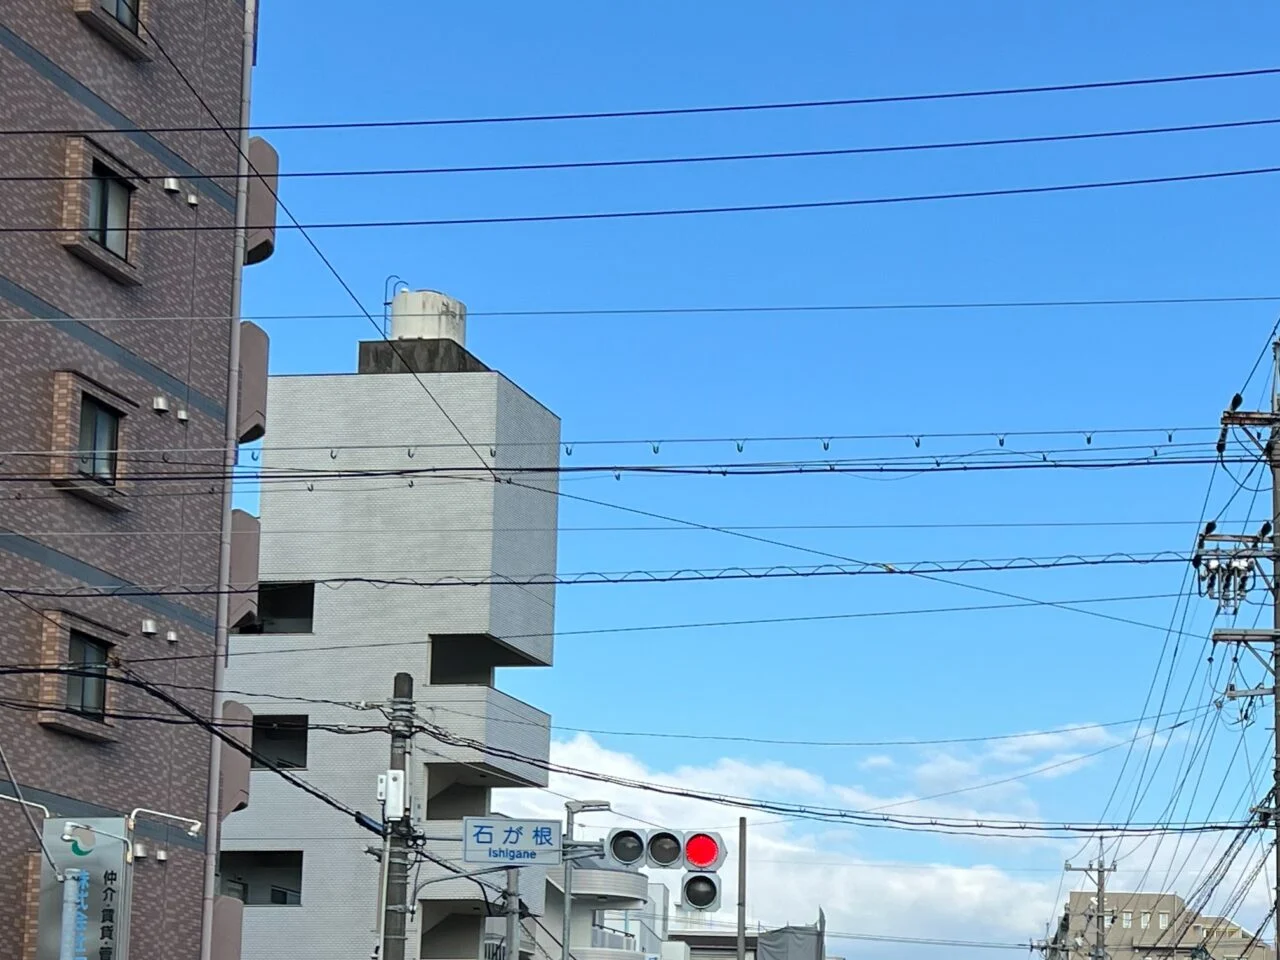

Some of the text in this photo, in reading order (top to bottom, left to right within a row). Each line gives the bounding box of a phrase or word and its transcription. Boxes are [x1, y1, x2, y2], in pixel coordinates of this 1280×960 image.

[472, 824, 554, 846] 石が根
[488, 847, 537, 860] Ishigane
